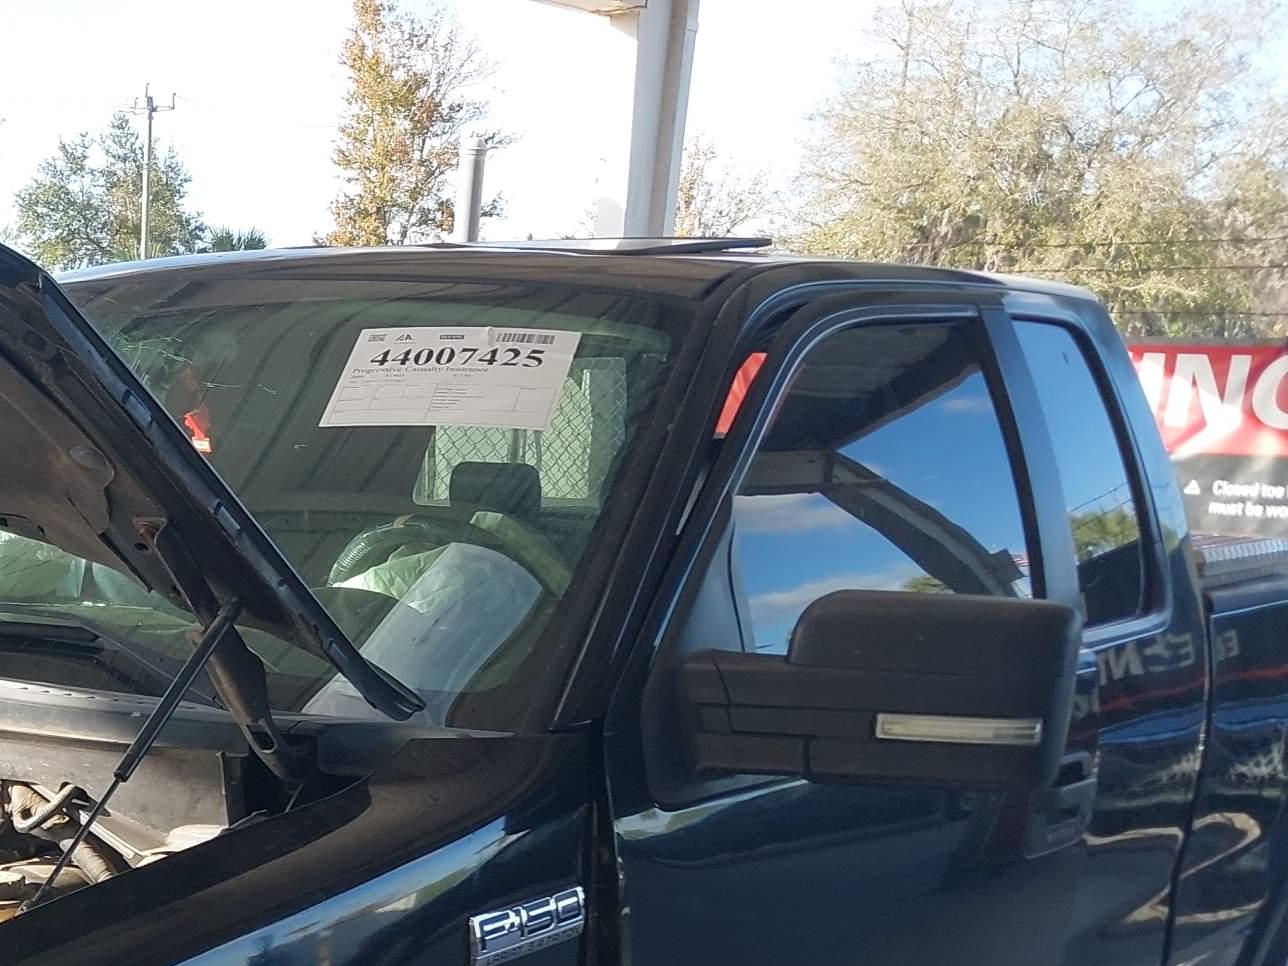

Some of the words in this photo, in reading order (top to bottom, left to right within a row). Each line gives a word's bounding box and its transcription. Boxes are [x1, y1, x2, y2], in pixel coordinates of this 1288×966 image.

[369, 346, 545, 368] 44007425
[352, 366, 402, 375] Progressive
[405, 366, 442, 374] Casualty
[1212, 479, 1259, 497] Closed
[1208, 501, 1244, 516] must
[1245, 501, 1264, 517] be
